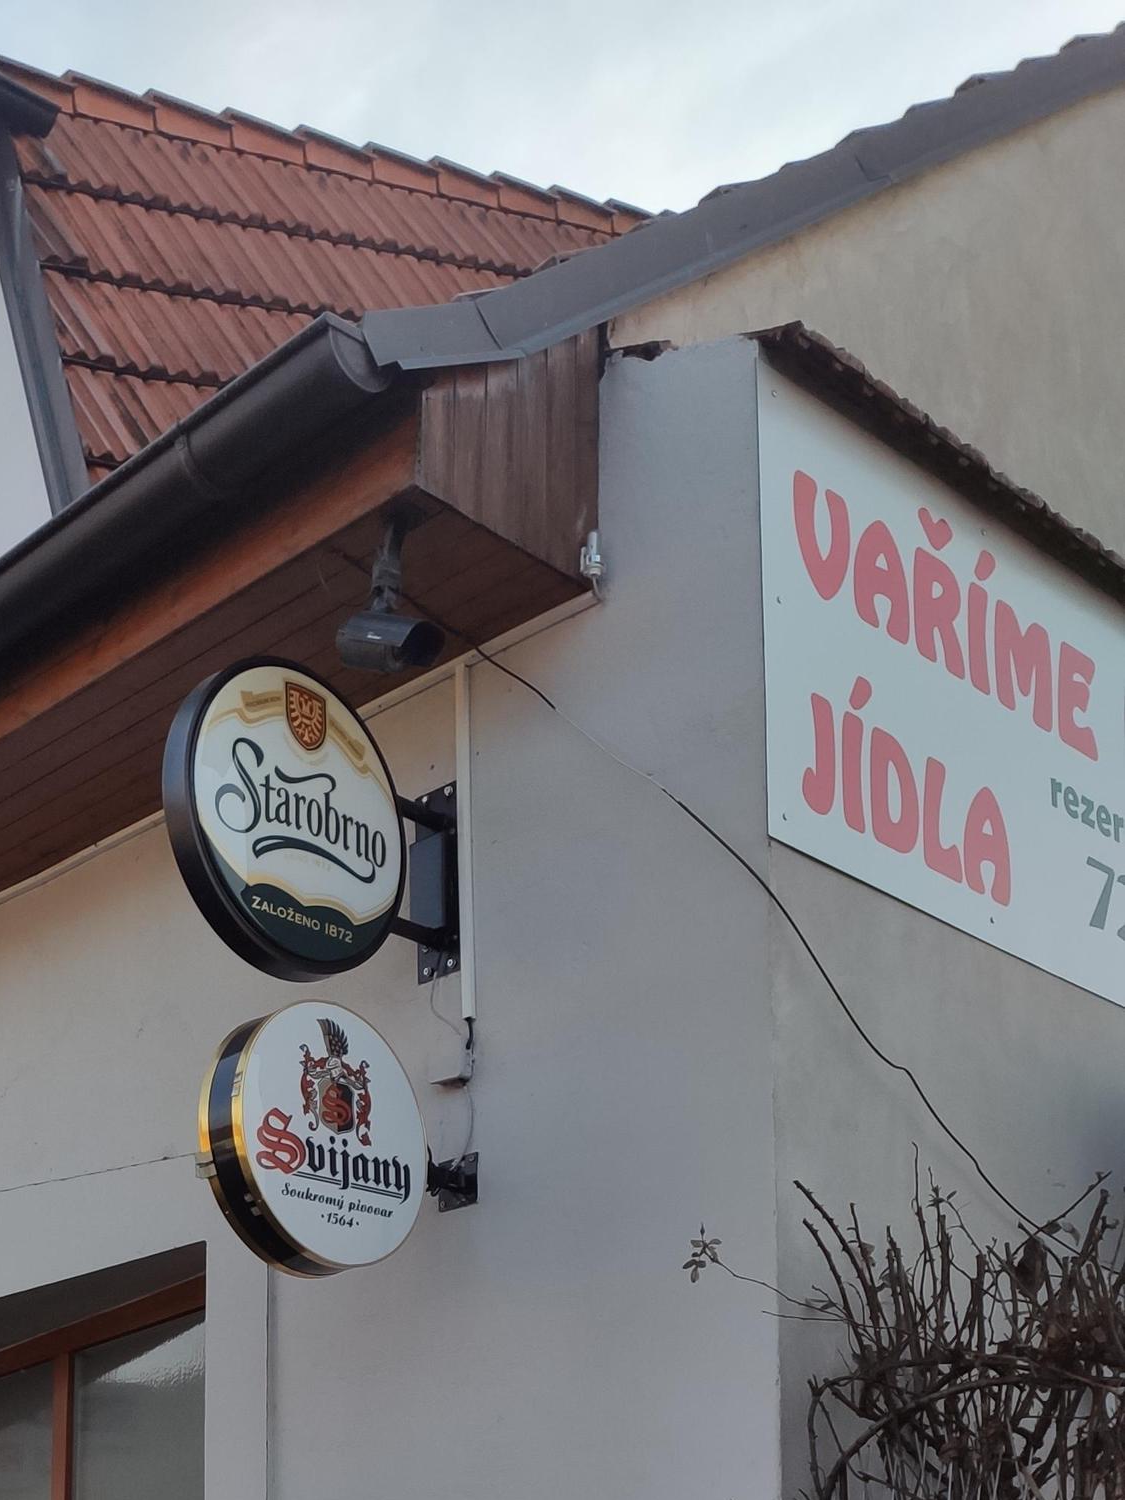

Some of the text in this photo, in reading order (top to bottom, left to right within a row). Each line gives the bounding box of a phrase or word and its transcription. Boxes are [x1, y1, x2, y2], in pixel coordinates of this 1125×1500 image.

[793, 470, 1098, 760] VAŘÍME
[215, 737, 386, 883] Starobrno
[802, 675, 1010, 906] JÍDLA
[251, 895, 353, 943] ZALOŽENO 1872
[256, 1107, 411, 1204] Svijany
[281, 1182, 394, 1218] Soukromý pivovar
